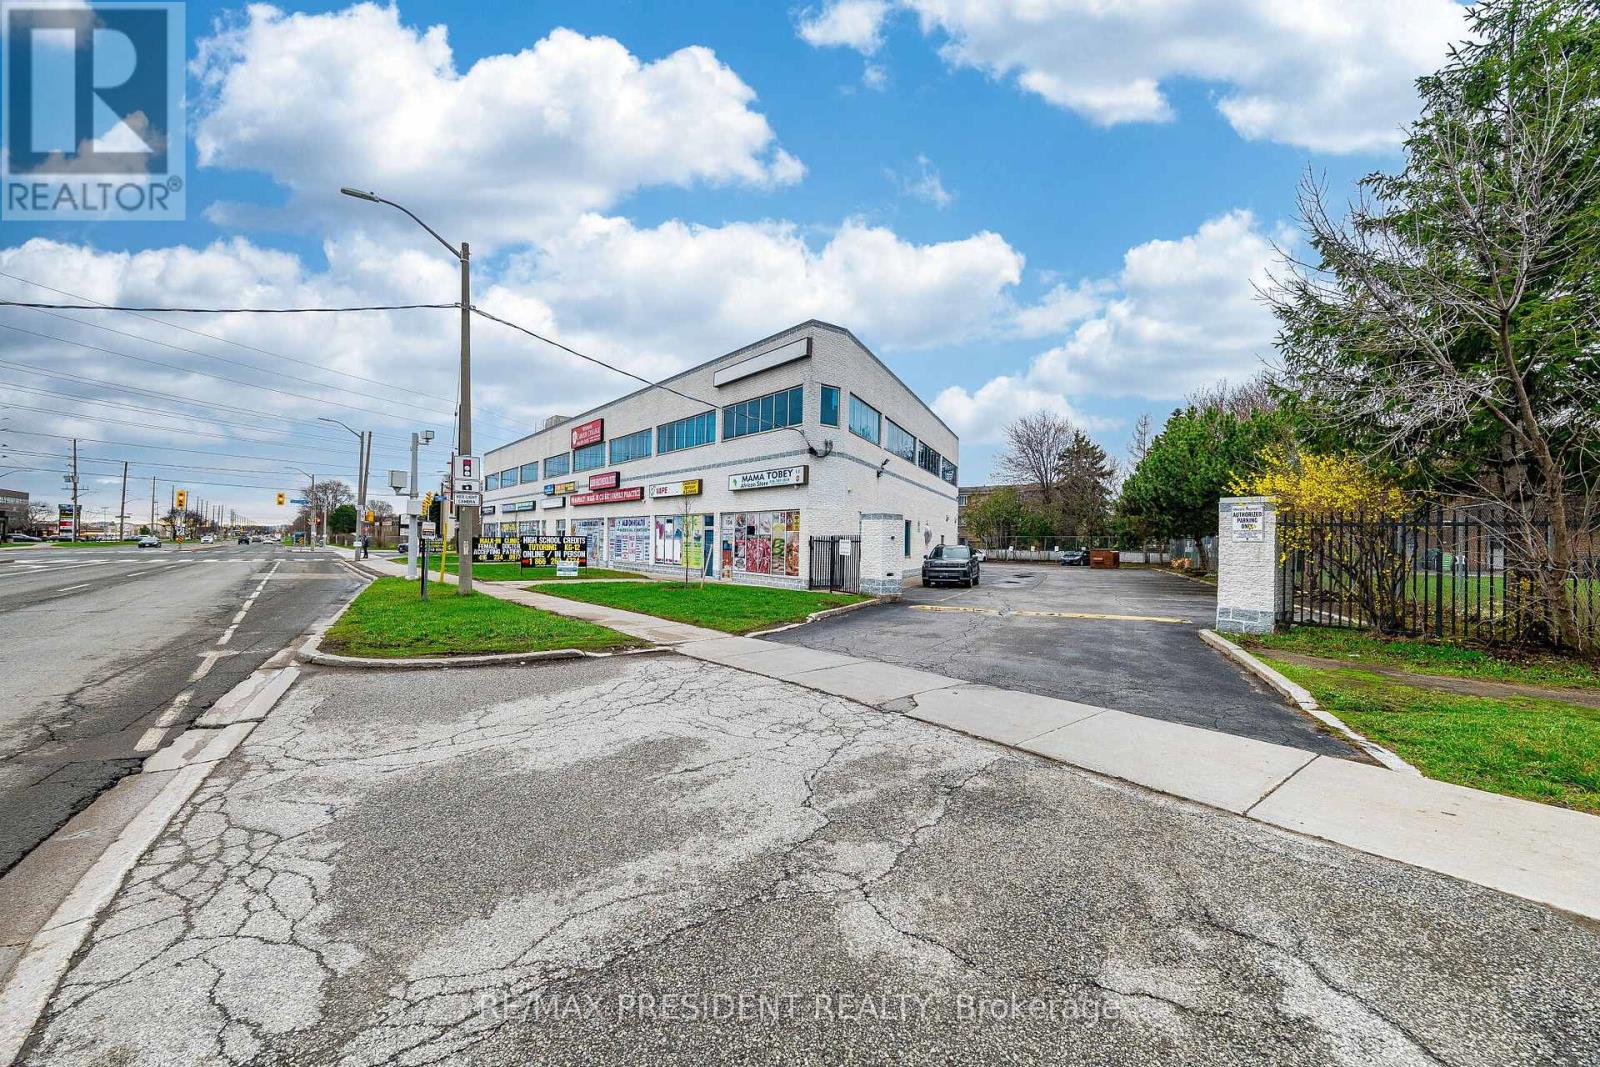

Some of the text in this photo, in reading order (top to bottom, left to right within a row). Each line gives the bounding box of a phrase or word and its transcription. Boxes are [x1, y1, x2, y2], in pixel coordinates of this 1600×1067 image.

[741, 474, 765, 482] MAMA
[766, 468, 794, 480] TOBEY
[656, 486, 668, 495] VAPE
[522, 536, 586, 544] HIGH SCHOOL CREDITS
[477, 543, 498, 551] FEMALE
[528, 543, 581, 551] TUTORING KG-12
[522, 550, 545, 558] ONLINE
[554, 550, 561, 558] IN
[562, 550, 586, 558] PERSON
